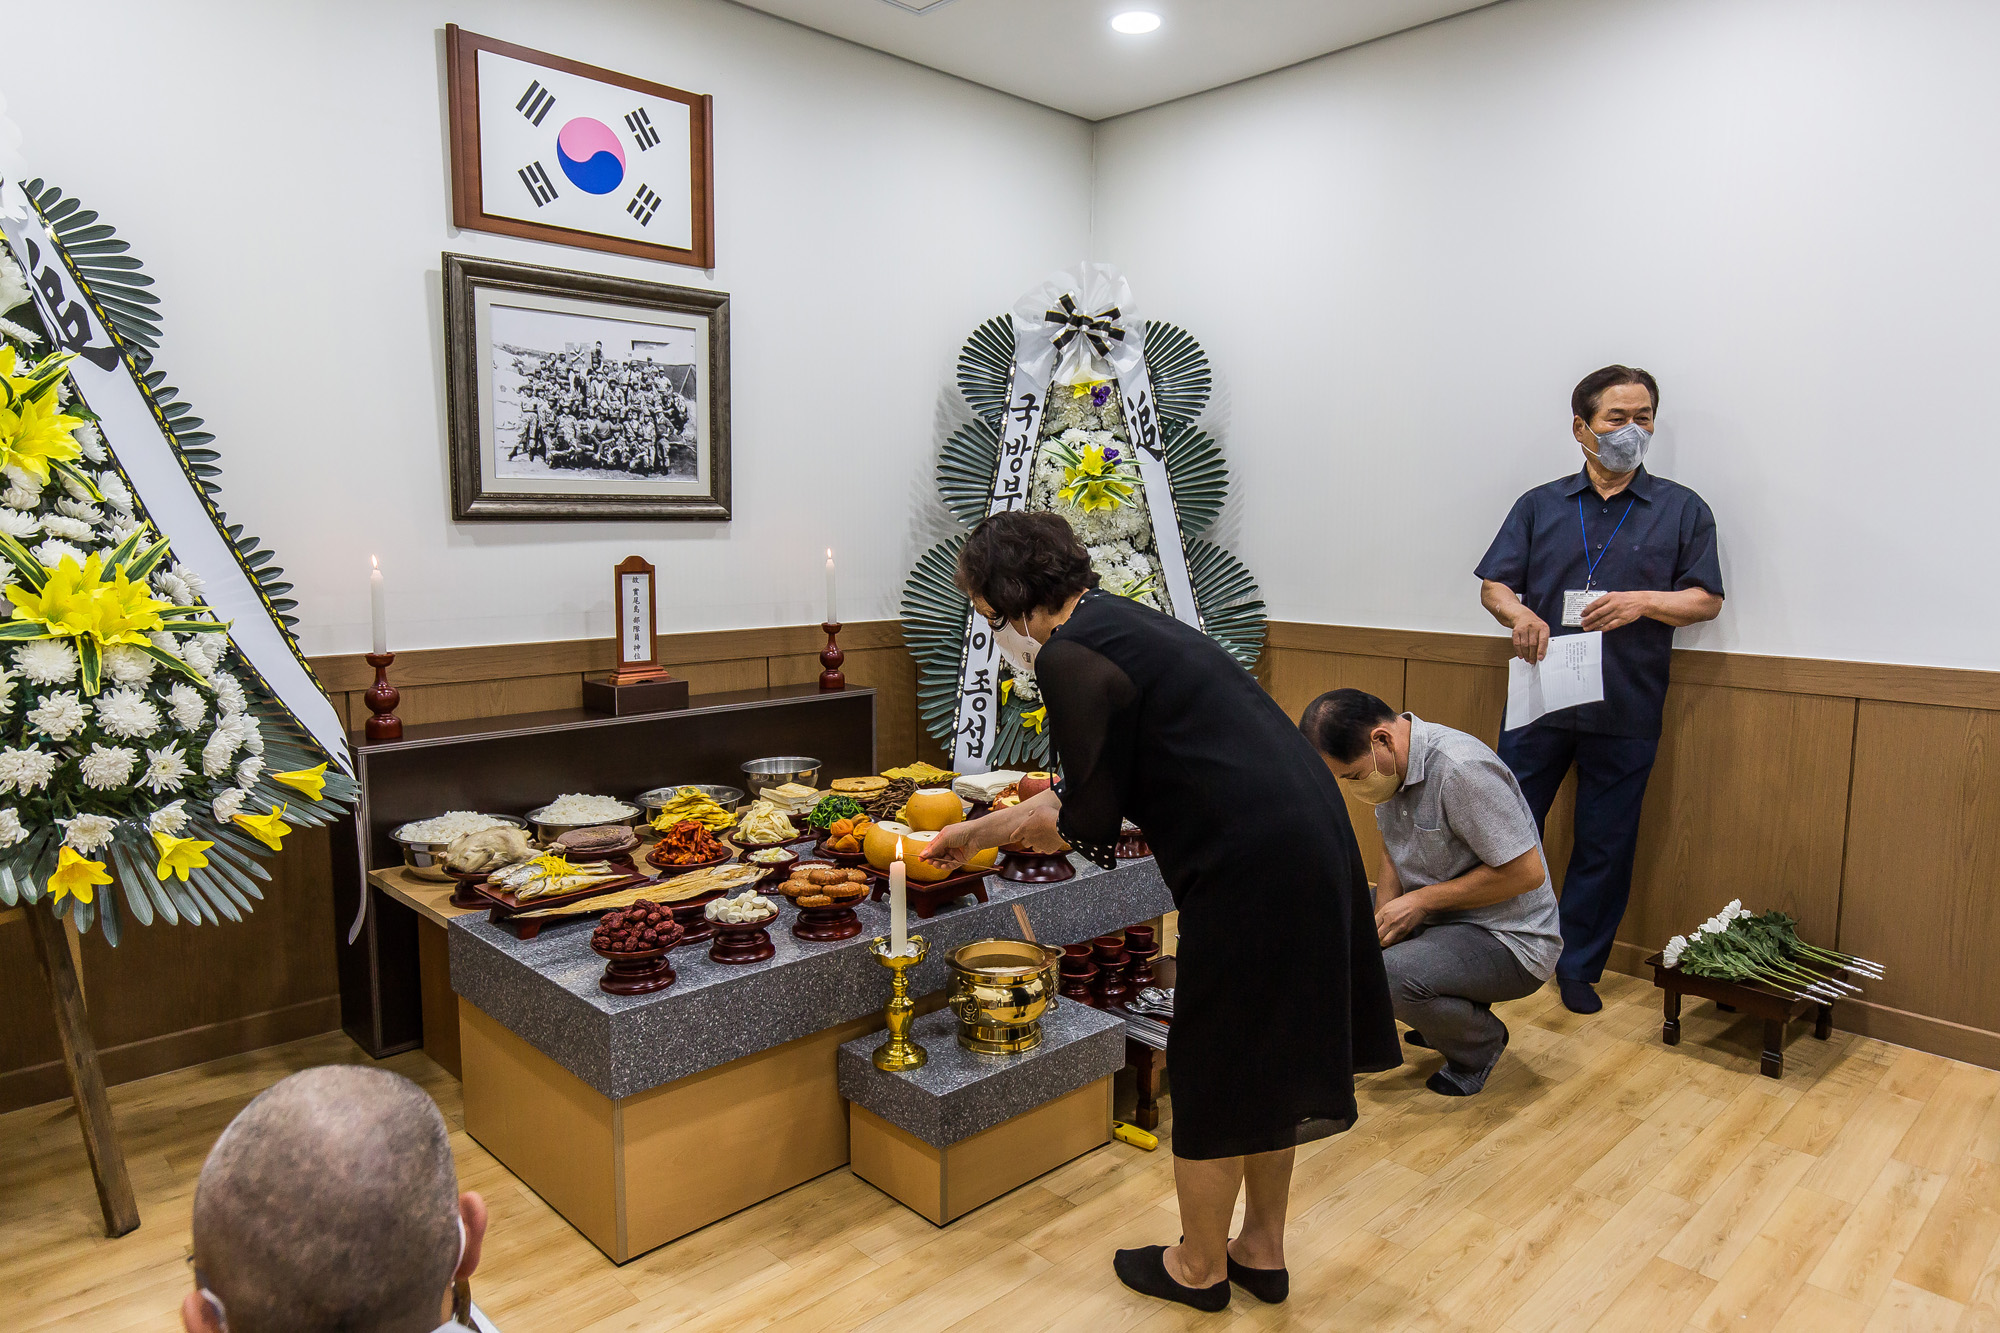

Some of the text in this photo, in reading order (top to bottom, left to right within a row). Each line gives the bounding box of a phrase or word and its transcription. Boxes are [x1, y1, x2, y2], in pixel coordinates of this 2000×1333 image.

[1127, 390, 1164, 462] 追
[958, 393, 1040, 758] 국방부 이종섭
